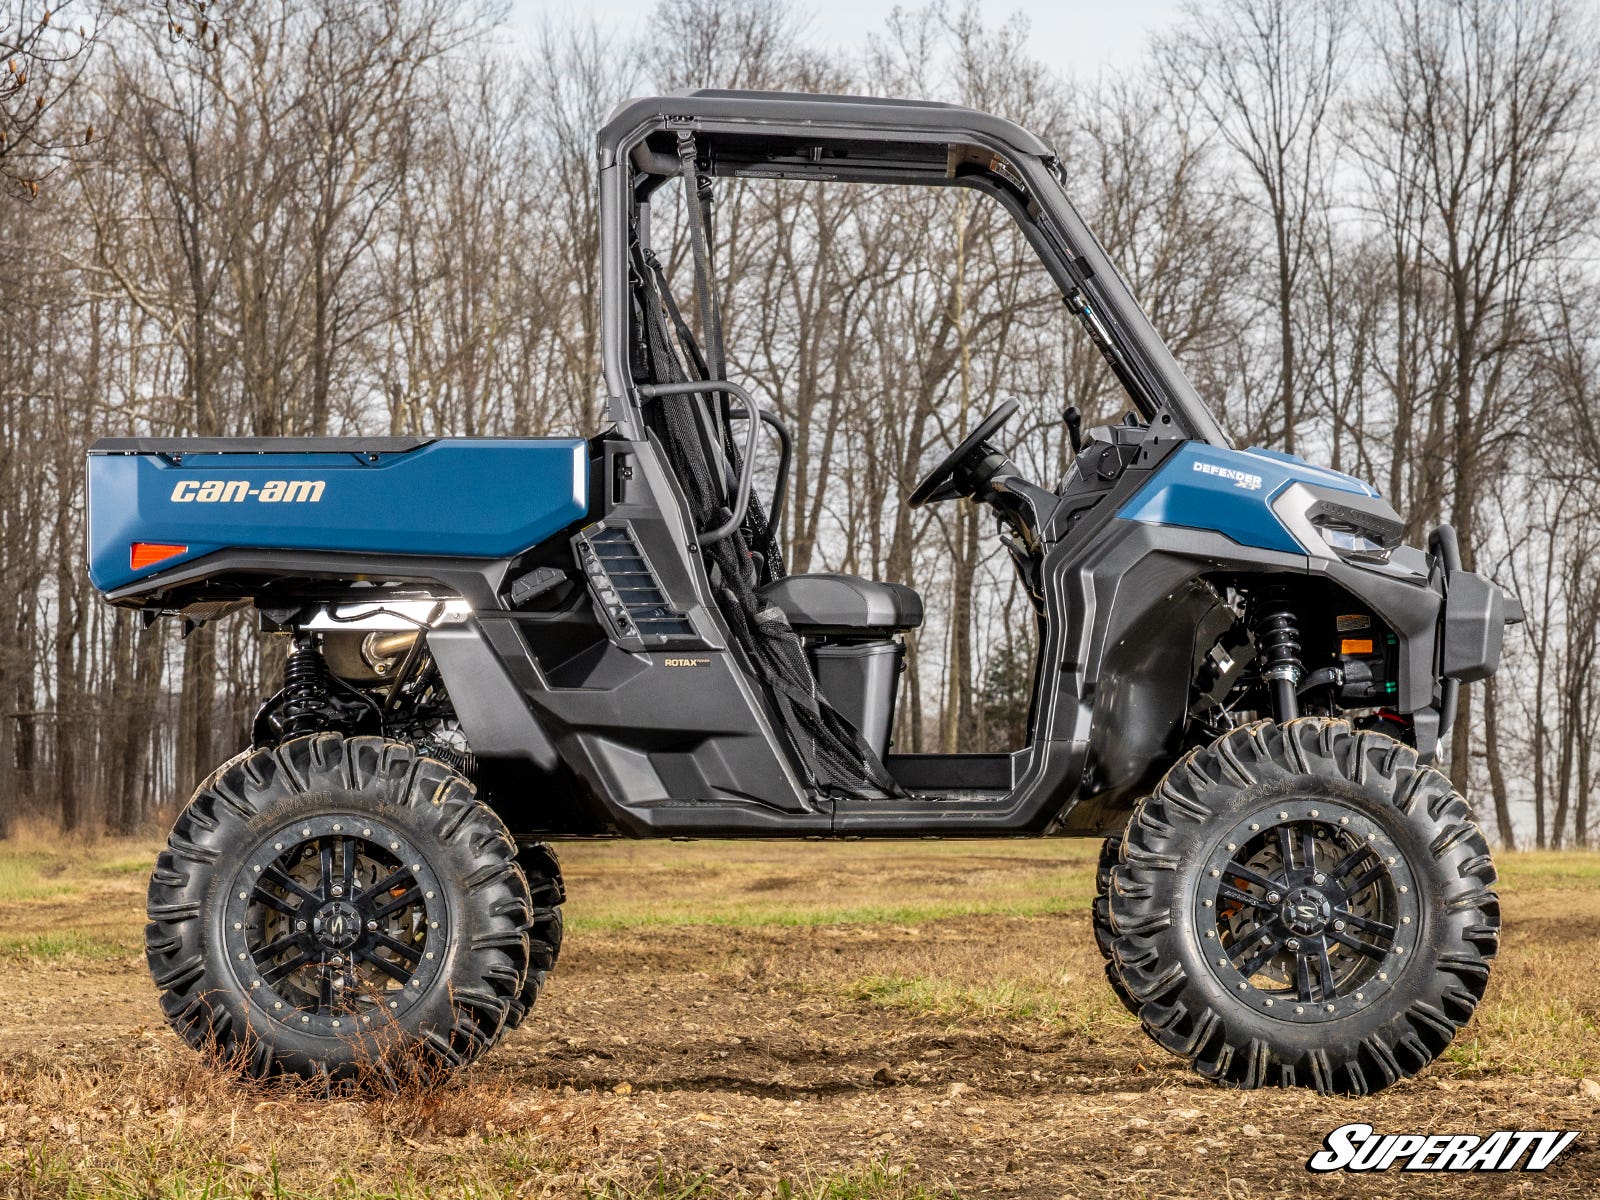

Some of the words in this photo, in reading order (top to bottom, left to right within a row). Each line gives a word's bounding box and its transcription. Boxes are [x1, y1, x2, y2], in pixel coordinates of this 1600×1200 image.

[1193, 461, 1262, 485] DEFENDER
[170, 480, 326, 503] can-am
[664, 659, 697, 667] ROTAX
